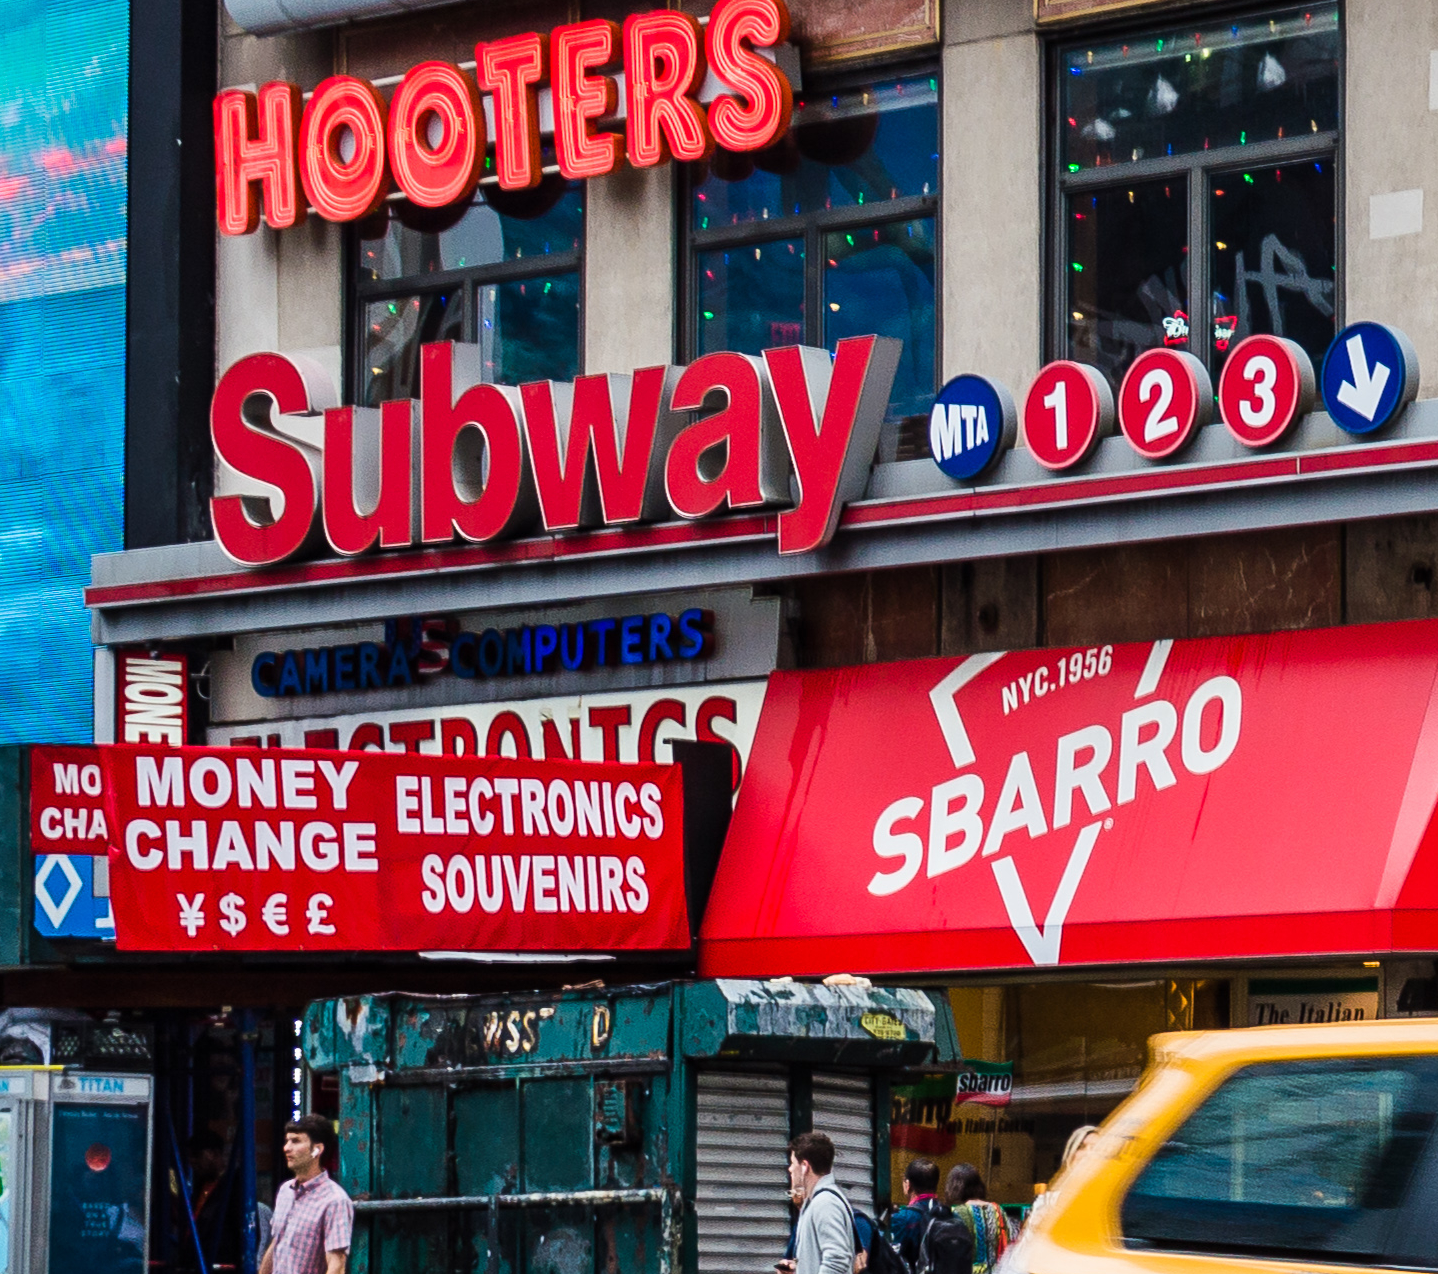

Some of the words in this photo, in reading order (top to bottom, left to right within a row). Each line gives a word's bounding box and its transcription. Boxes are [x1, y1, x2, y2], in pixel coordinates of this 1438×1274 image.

[930, 402, 990, 462] MTA
[1043, 380, 1069, 450] 1
[1139, 368, 1179, 443] 2
[1239, 355, 1278, 428] 3
[210, 333, 897, 567] Subway
[251, 639, 414, 698] CAMERA
[451, 607, 706, 680] COMPUTERS
[1001, 644, 1114, 716] NYC.1956
[124, 657, 184, 748] MONE
[136, 755, 361, 813] MONEY
[395, 775, 662, 841] ELECTRONICS
[866, 674, 1244, 897] SBARRO
[124, 819, 380, 874] CHANGE
[180, 892, 206, 937] ¥
[219, 891, 246, 938] $
[262, 892, 289, 936] €
[305, 892, 336, 936] £
[419, 853, 650, 916] SOUVENIRS
[1256, 1002, 1290, 1024] The
[1299, 1001, 1366, 1023] Italian
[78, 1076, 125, 1093] TITAN
[959, 1072, 1011, 1093] sbarro
